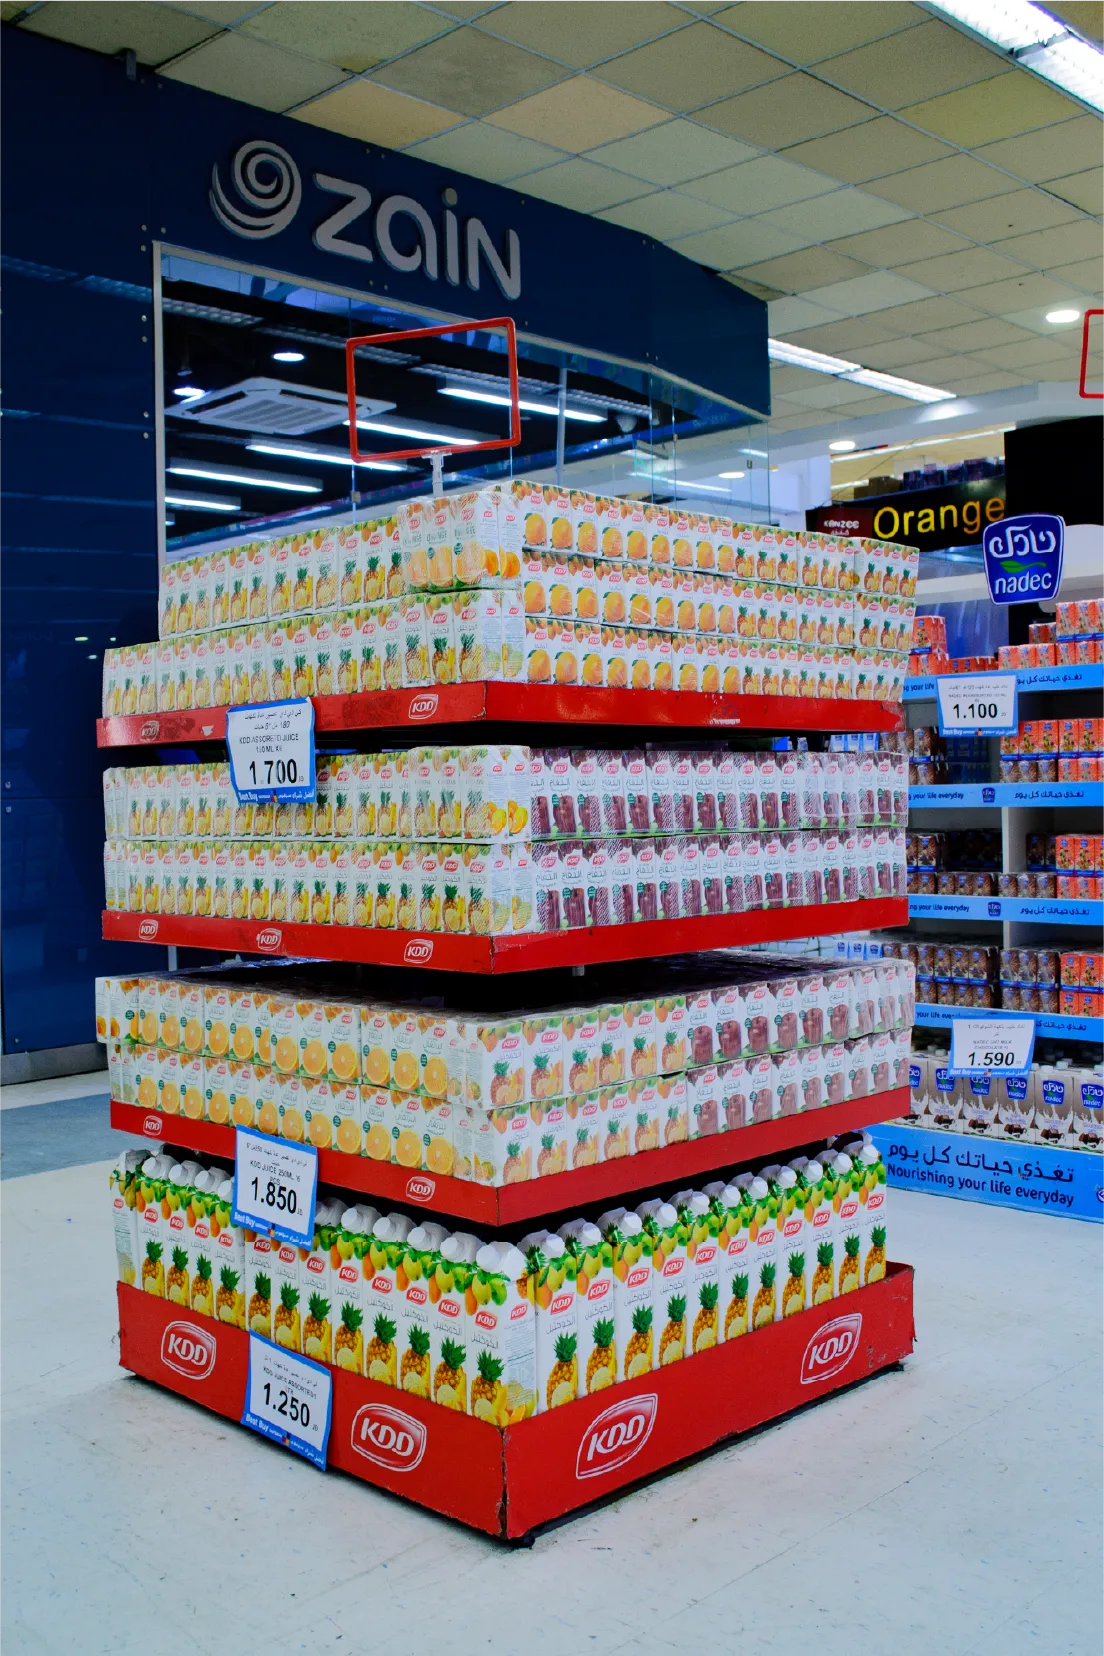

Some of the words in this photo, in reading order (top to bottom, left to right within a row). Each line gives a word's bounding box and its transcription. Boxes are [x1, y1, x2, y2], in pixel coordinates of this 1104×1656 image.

[873, 498, 1005, 540] Orange
[995, 571, 1052, 594] nadec
[1025, 674, 1037, 684] كل
[1038, 674, 1060, 683] حياتك
[911, 683, 923, 692] your
[412, 700, 435, 713] KDD
[953, 703, 998, 719] 1.100
[913, 793, 926, 801] your
[938, 792, 964, 801] everyday
[1028, 790, 1040, 798] كل
[1041, 790, 1064, 798] حياتك
[944, 905, 970, 913] everyday
[1034, 907, 1045, 915] كل
[1046, 907, 1069, 916] حياتك
[141, 924, 157, 935] KDD
[259, 935, 279, 946] KDD
[408, 945, 430, 958] KDD
[916, 1011, 929, 1019] your
[542, 1031, 559, 1042] KDD
[580, 1027, 597, 1038] KDD
[502, 1038, 520, 1049] KDD
[968, 1051, 1015, 1067] 1.590
[1045, 1095, 1062, 1103] nadec
[1083, 1099, 1101, 1107] nadec
[548, 1112, 563, 1122] KDD
[583, 1105, 597, 1115] KDD
[145, 1120, 161, 1131] KDD
[512, 1117, 527, 1130] KDD
[888, 1144, 918, 1165] يوم
[923, 1145, 951, 1165] كل
[250, 1160, 261, 1170] KDD
[262, 1163, 277, 1175] JUICE
[956, 1150, 1013, 1176] حياتك
[1018, 1161, 1074, 1183] تغذي
[409, 1181, 433, 1196] KDD
[887, 1163, 954, 1188] Nourishing
[958, 1174, 987, 1191] your
[990, 1179, 1011, 1196] life
[1015, 1186, 1074, 1208] everyday
[251, 1177, 297, 1214] 1.850
[865, 1195, 883, 1209] KDD
[145, 1209, 157, 1222] KDD
[839, 1203, 857, 1217] KDD
[170, 1216, 183, 1230] KDD
[234, 1211, 246, 1223] Best
[245, 1215, 255, 1228] Buy
[812, 1212, 830, 1226] KDD
[195, 1224, 208, 1238] KDD
[782, 1221, 802, 1236] KDD
[219, 1234, 232, 1247] KDD
[756, 1231, 773, 1244] KDD
[254, 1239, 270, 1252] KDD
[726, 1240, 747, 1254] KDD
[279, 1247, 295, 1263] KDD
[694, 1248, 716, 1264] KDD
[307, 1257, 324, 1273] KDD
[662, 1259, 684, 1275] KDD
[339, 1266, 357, 1282] KDD
[626, 1270, 648, 1287] KDD
[372, 1277, 391, 1293] KDD
[587, 1281, 610, 1299] KDD
[406, 1287, 426, 1304] KDD
[438, 1300, 460, 1317] KDD
[551, 1295, 573, 1313] KDD
[510, 1306, 527, 1319] KDD
[476, 1311, 496, 1329] KDD
[168, 1333, 208, 1366] KDD
[808, 1330, 853, 1371] KDD
[263, 1382, 310, 1427] 1.250
[245, 1413, 257, 1426] Best
[258, 1419, 269, 1432] Buy
[361, 1417, 415, 1457] KDD
[586, 1414, 646, 1462] KDD
